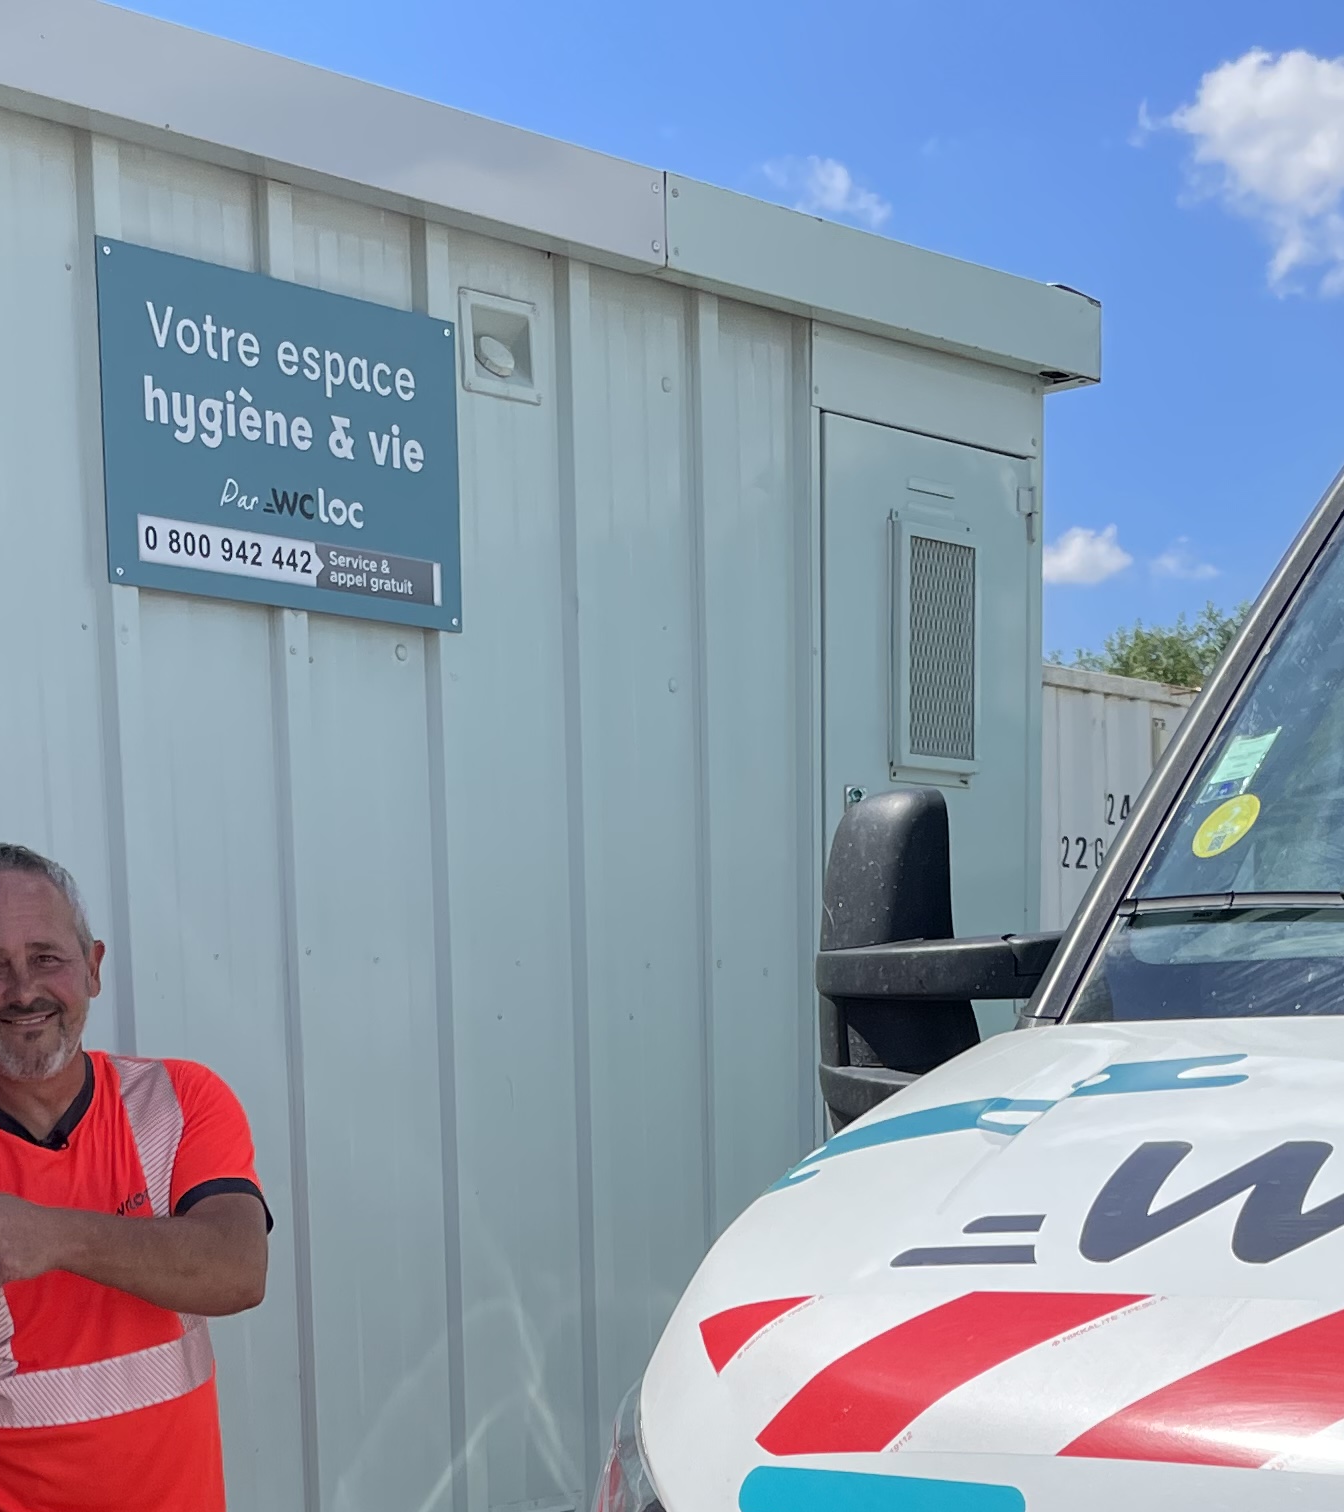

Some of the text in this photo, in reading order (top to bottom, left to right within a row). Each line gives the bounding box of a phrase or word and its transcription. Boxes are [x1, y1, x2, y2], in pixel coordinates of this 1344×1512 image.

[146, 301, 416, 401] Votre espace
[144, 375, 425, 472] hygiène & vie
[220, 478, 258, 511] Par
[145, 526, 312, 574] 0 800 942 442
[329, 551, 391, 574] Service &
[330, 570, 413, 596] appel gratuit
